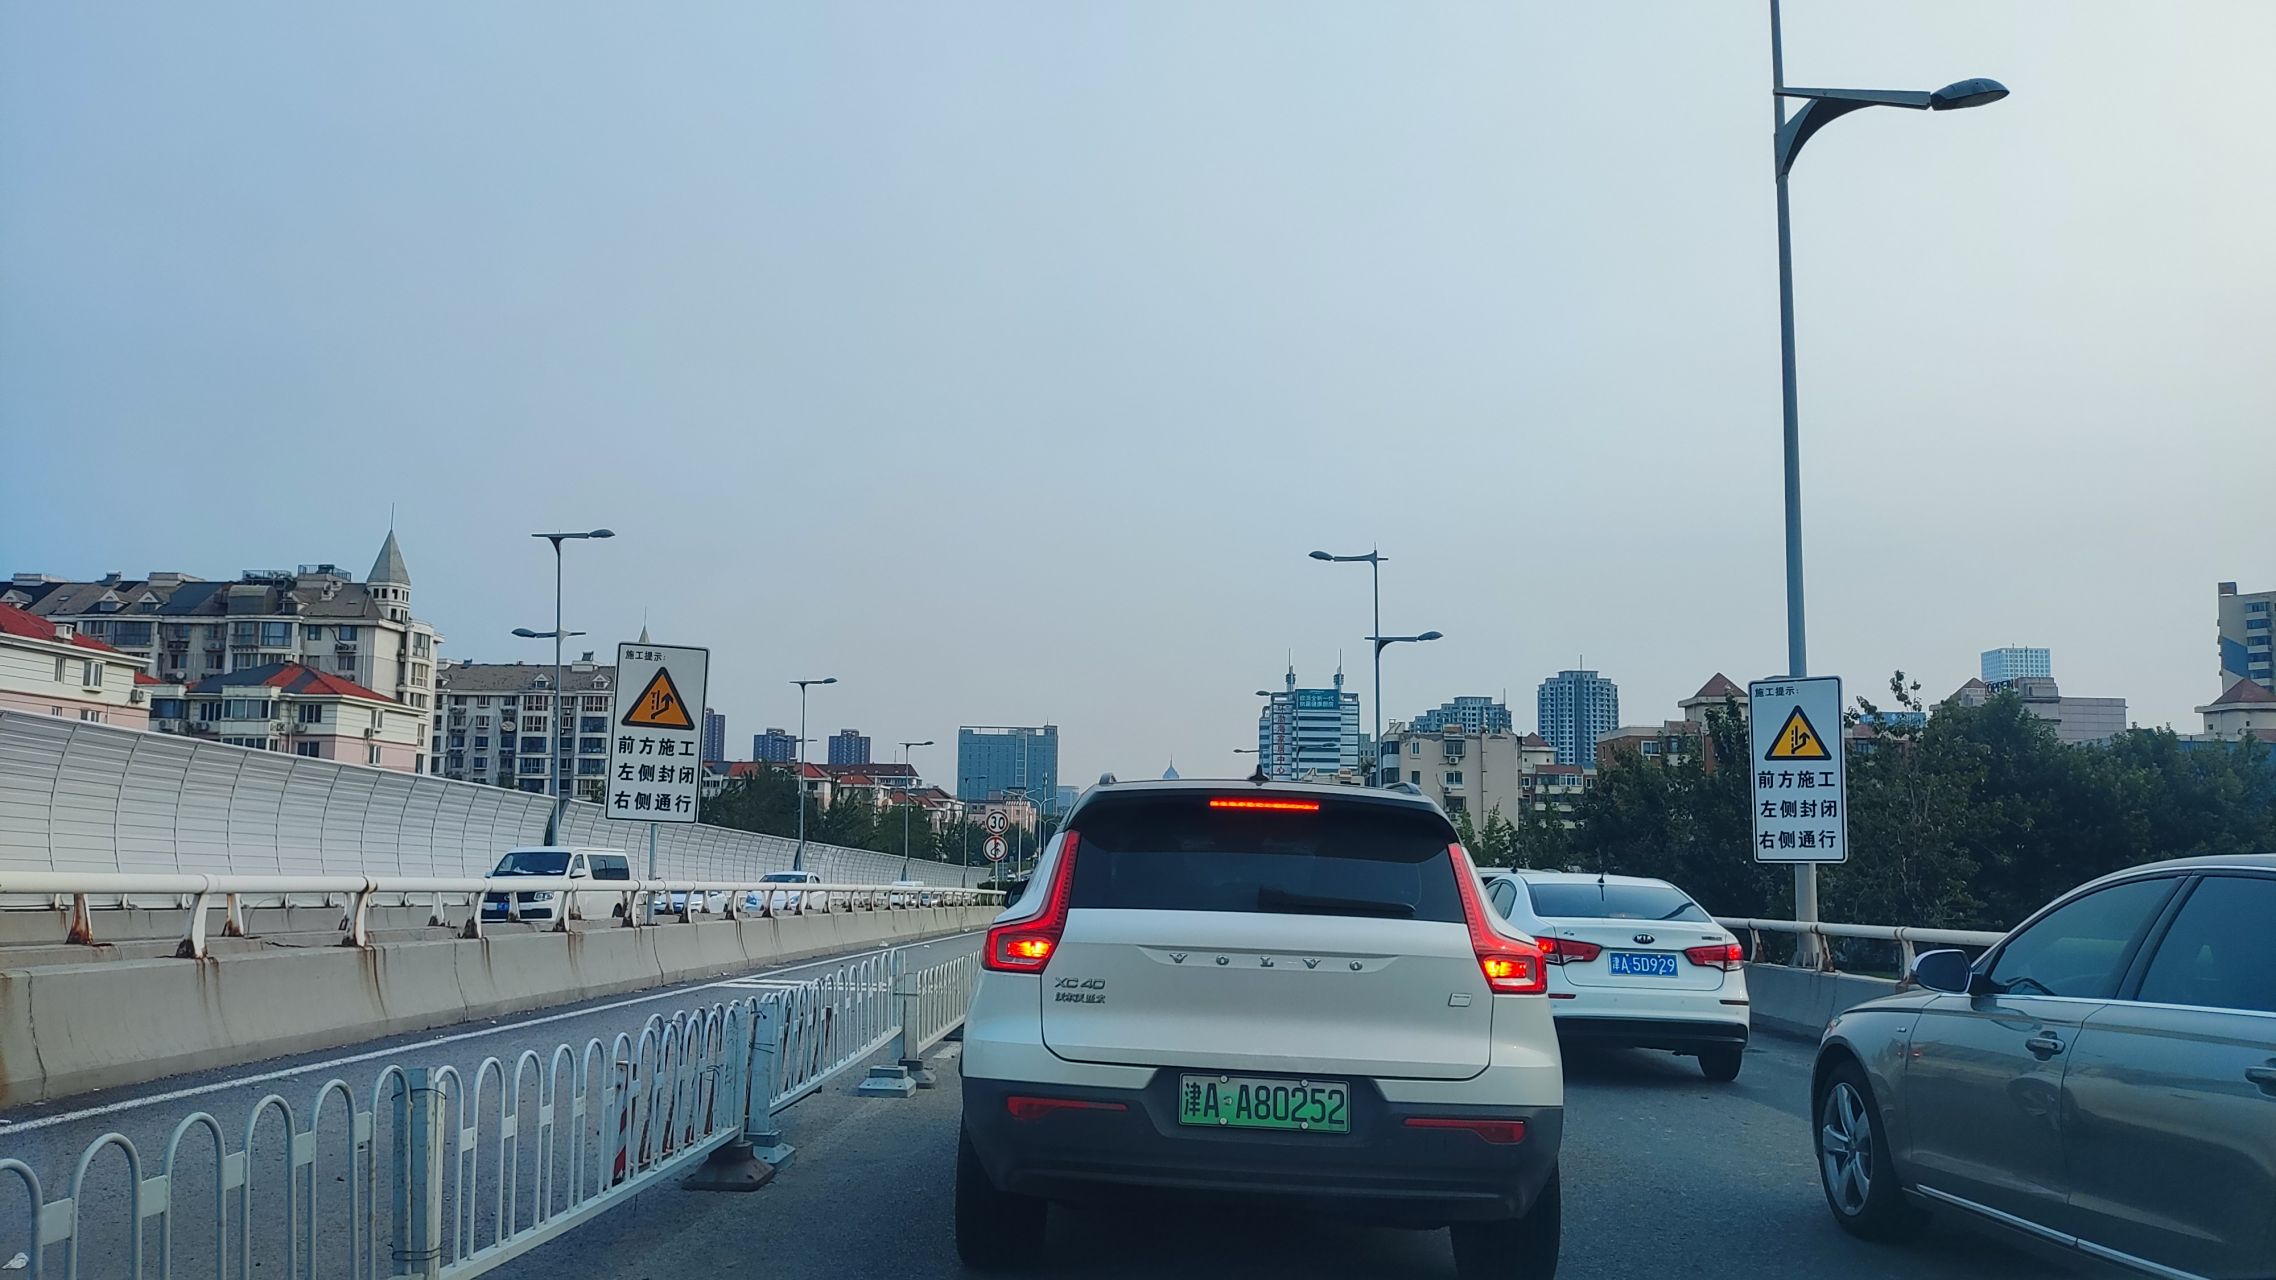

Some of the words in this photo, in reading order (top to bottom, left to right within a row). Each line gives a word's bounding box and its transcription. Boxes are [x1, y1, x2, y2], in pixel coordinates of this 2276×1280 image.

[617, 735, 695, 756] 前方施工
[617, 763, 694, 784] 左侧封闭
[1757, 770, 1835, 789] 前方施工
[614, 791, 692, 813] 右侧通行
[1760, 800, 1838, 818] 左侧封闭
[990, 816, 1005, 829] 30
[1759, 830, 1836, 849] 右侧通行
[1168, 952, 1364, 972] VOLVO
